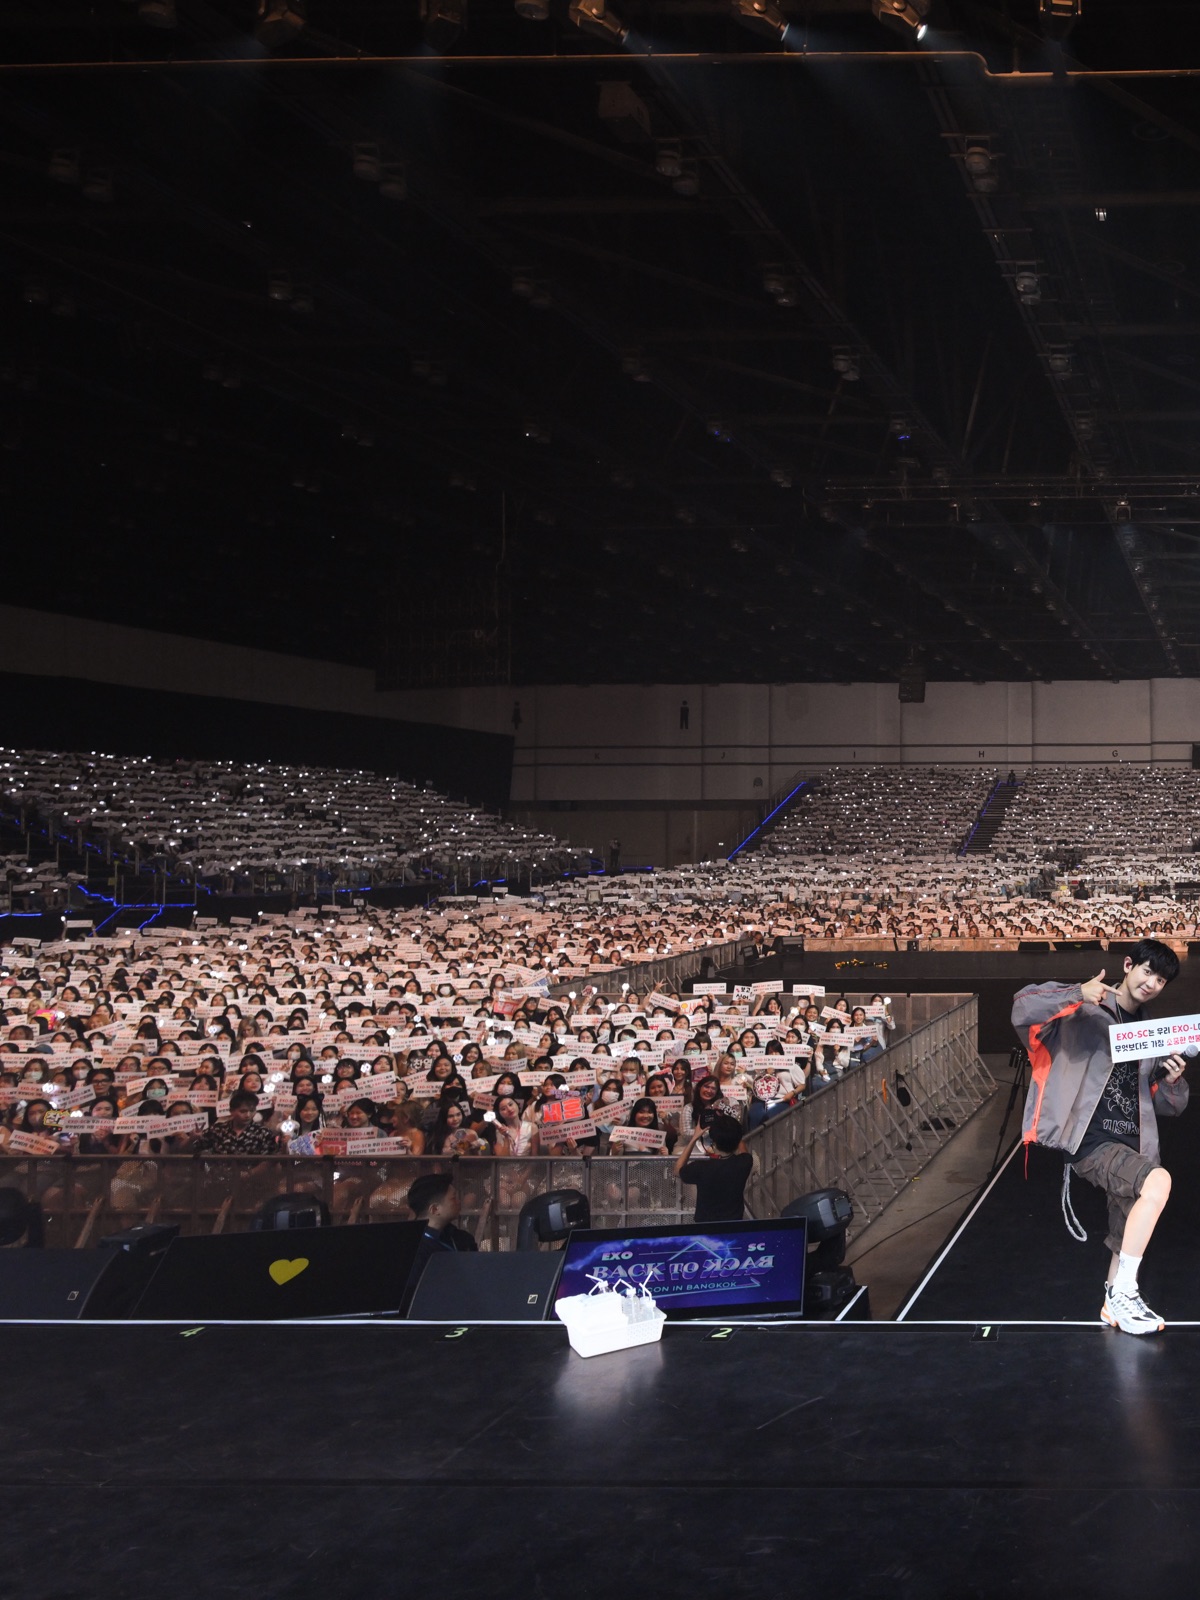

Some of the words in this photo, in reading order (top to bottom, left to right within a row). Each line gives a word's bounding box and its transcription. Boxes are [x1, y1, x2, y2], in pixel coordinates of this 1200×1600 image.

[1116, 1029, 1155, 1041] EXO-SC는
[1156, 1027, 1171, 1036] 우리
[1114, 1041, 1149, 1053] 무엇보다도
[1150, 1039, 1165, 1048] 가장
[1166, 1036, 1187, 1046] 소중한
[601, 1251, 633, 1261] EXO
[747, 1242, 765, 1251] SC
[592, 1262, 665, 1279] BACK
[670, 1262, 699, 1275] TO
[686, 1281, 737, 1291] BANGKOK
[179, 1327, 206, 1337] 4
[445, 1327, 469, 1338] 3
[711, 1327, 733, 1338] 2
[981, 1326, 992, 1337] 1
